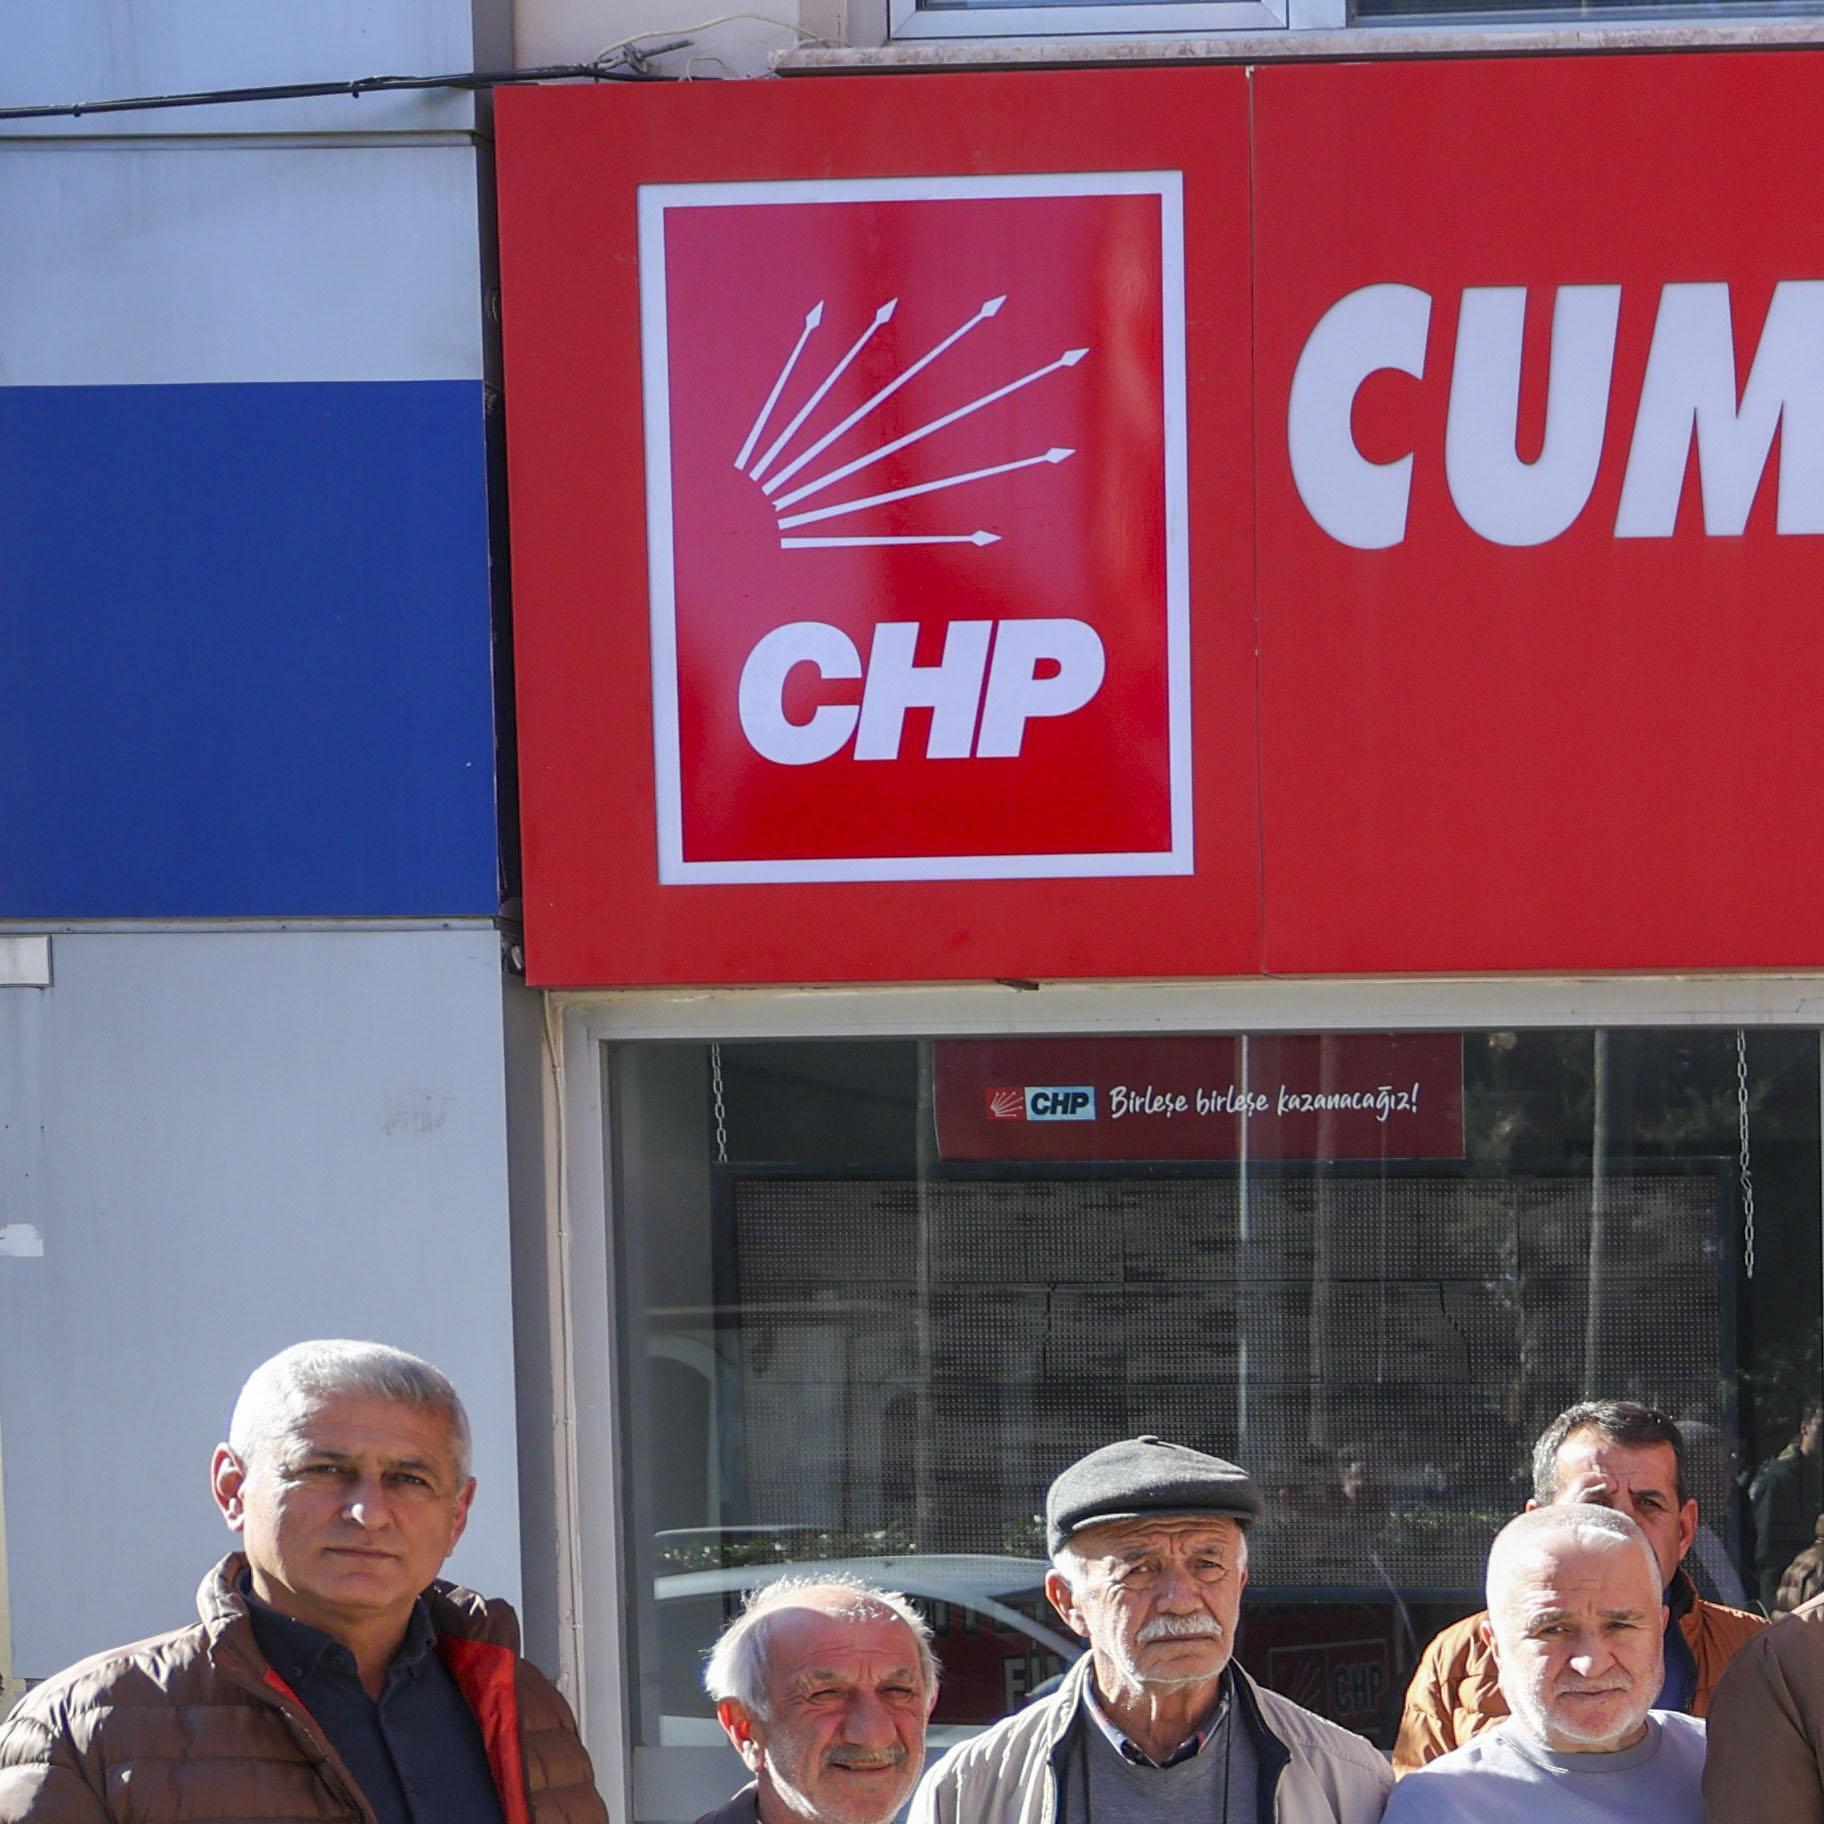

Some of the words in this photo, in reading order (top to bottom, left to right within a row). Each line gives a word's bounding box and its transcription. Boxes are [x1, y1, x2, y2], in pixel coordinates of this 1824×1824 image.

[737, 617, 1106, 766] CHP
[1030, 1091, 1090, 1116] CHP
[1109, 1085, 1189, 1119] Birleşe
[1195, 1084, 1269, 1119] birleşe
[1276, 1083, 1420, 1122] kazanacağız!
[1334, 1661, 1386, 1716] CHP
